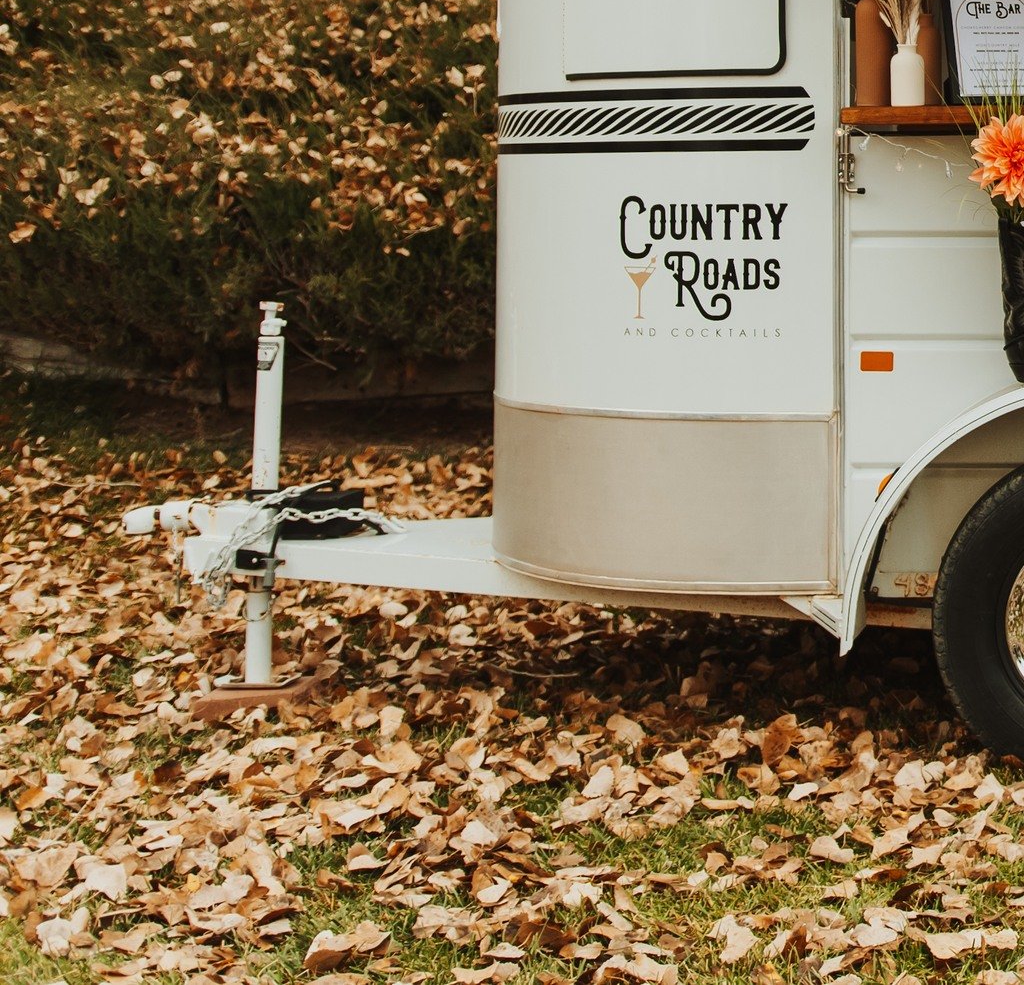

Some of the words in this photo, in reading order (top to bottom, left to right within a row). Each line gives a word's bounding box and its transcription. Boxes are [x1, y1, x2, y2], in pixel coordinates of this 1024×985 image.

[619, 195, 789, 259] COUNTRY
[663, 250, 781, 321] ROADS
[624, 327, 657, 337] AND
[670, 328, 782, 338] COCKTAILS
